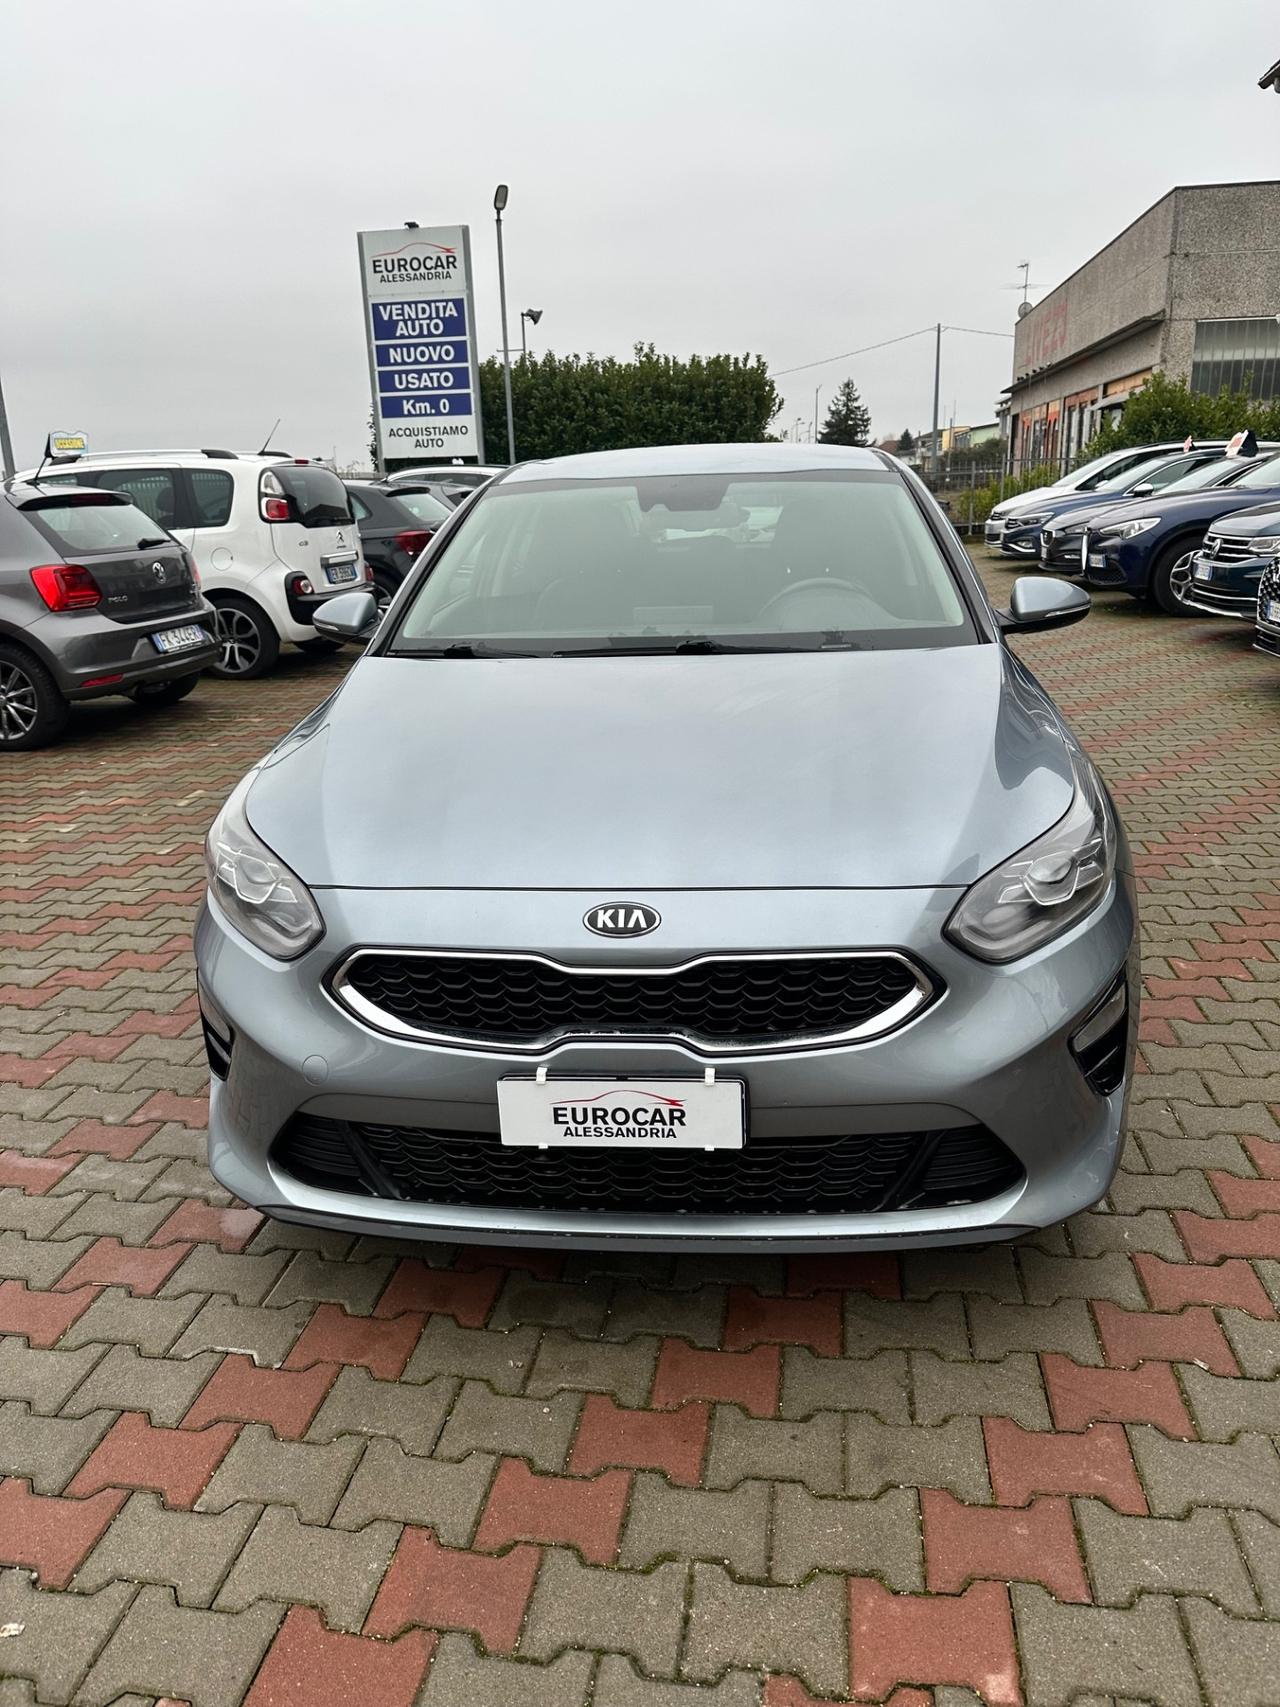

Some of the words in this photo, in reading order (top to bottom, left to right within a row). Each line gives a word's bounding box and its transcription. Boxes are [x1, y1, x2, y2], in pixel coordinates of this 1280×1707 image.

[373, 254, 457, 274] EUROCAR
[380, 271, 452, 283] ALESSANDRIA
[379, 302, 457, 321] VENDITA
[395, 319, 444, 337] AUTO
[389, 344, 455, 364] NUOVO
[394, 371, 454, 390] USATO
[402, 399, 435, 415] Km.
[440, 398, 450, 414] 0
[388, 425, 469, 438] ACQUISTIAMO
[414, 438, 444, 449] AUTO
[108, 595, 128, 604] POLO
[597, 908, 647, 929] KIA
[553, 1106, 687, 1127] EUROCAR
[563, 1126, 677, 1139] ALESSANDRIA
